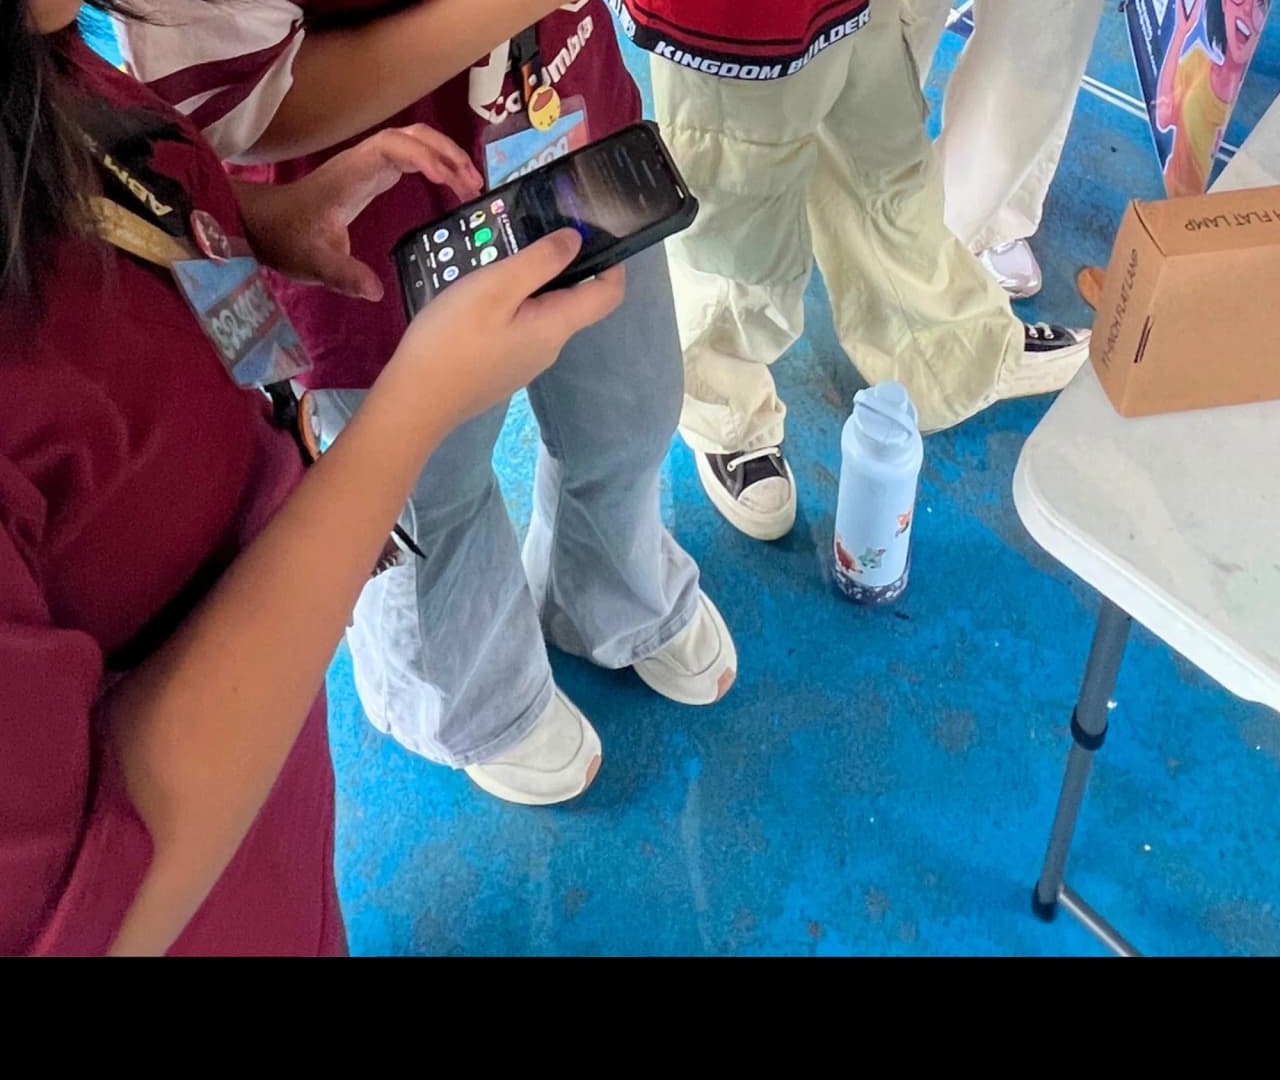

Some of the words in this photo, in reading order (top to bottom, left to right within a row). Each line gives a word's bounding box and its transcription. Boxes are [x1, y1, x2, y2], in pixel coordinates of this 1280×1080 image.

[654, 39, 783, 81] KINGDOM
[1183, 210, 1232, 233] LAMP
[1232, 208, 1273, 227] FLAT
